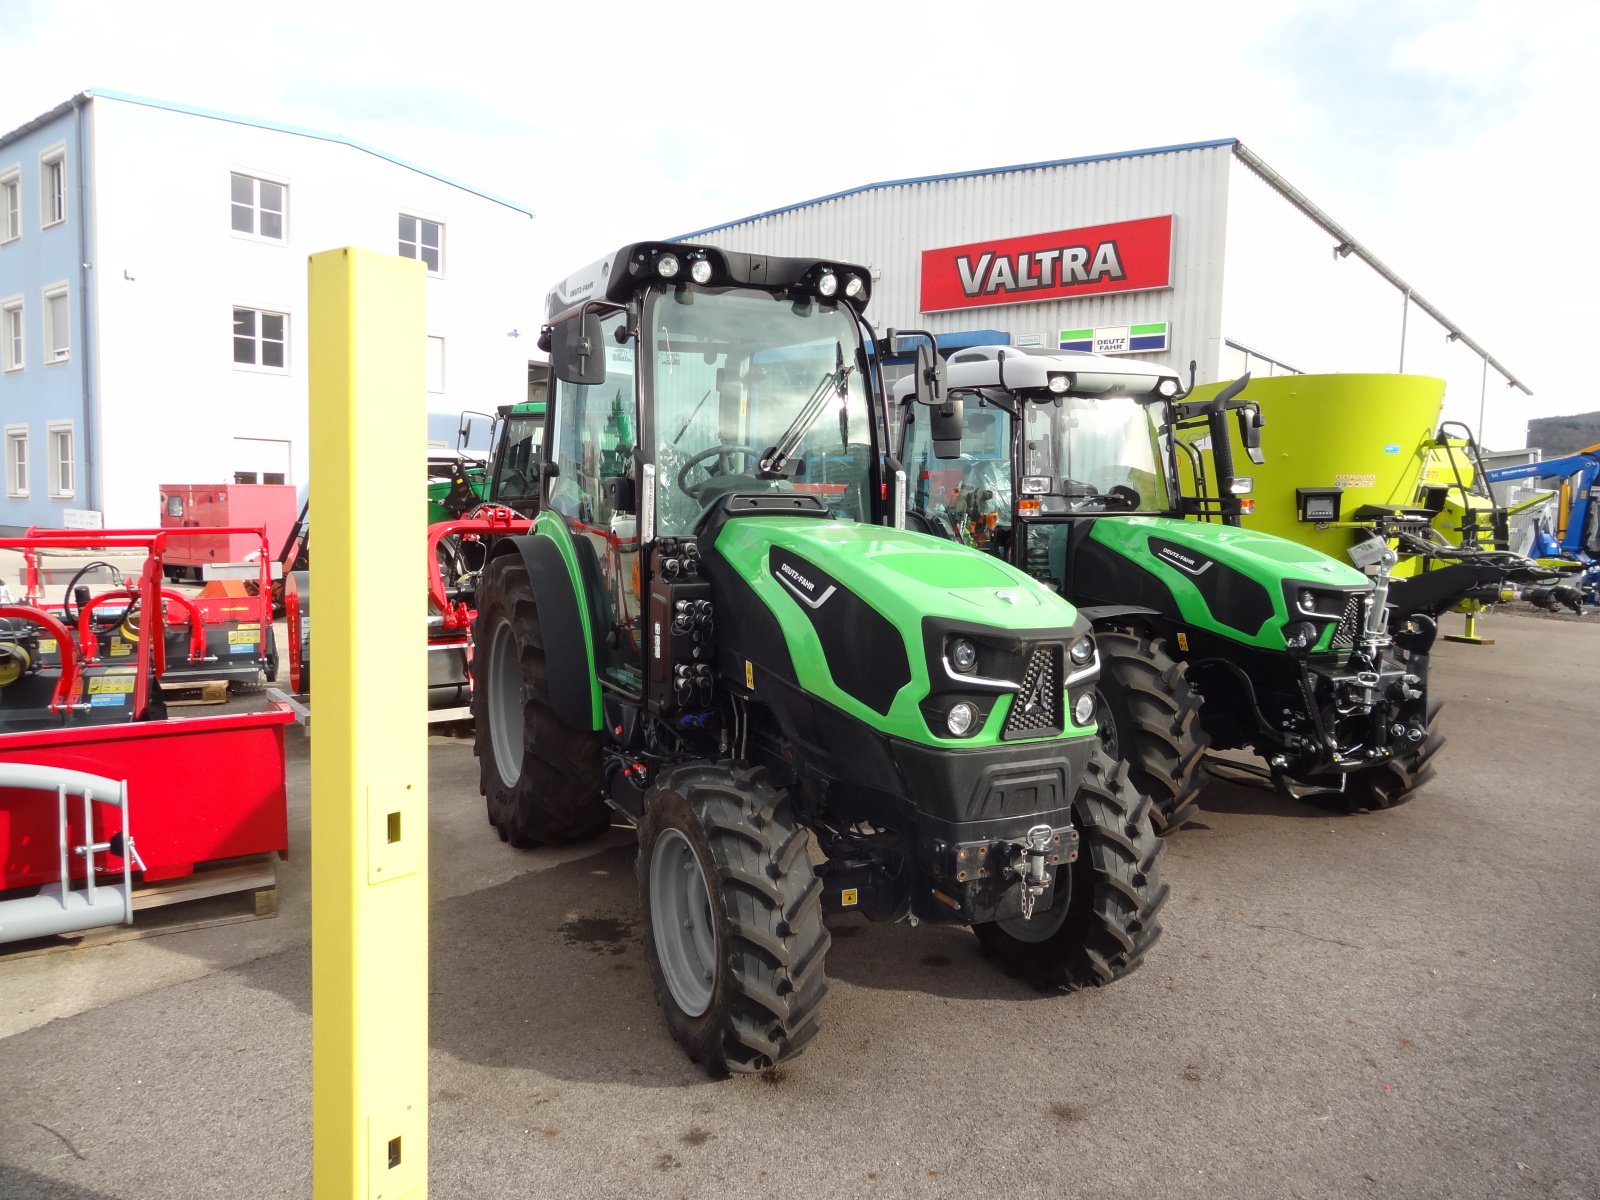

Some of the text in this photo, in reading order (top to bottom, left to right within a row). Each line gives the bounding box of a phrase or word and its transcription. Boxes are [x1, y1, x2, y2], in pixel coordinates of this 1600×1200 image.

[955, 241, 1126, 296] VALTRA
[1163, 547, 1195, 565] DEUTZ-FAHR
[781, 563, 815, 591] DEUTZ-FAHR
